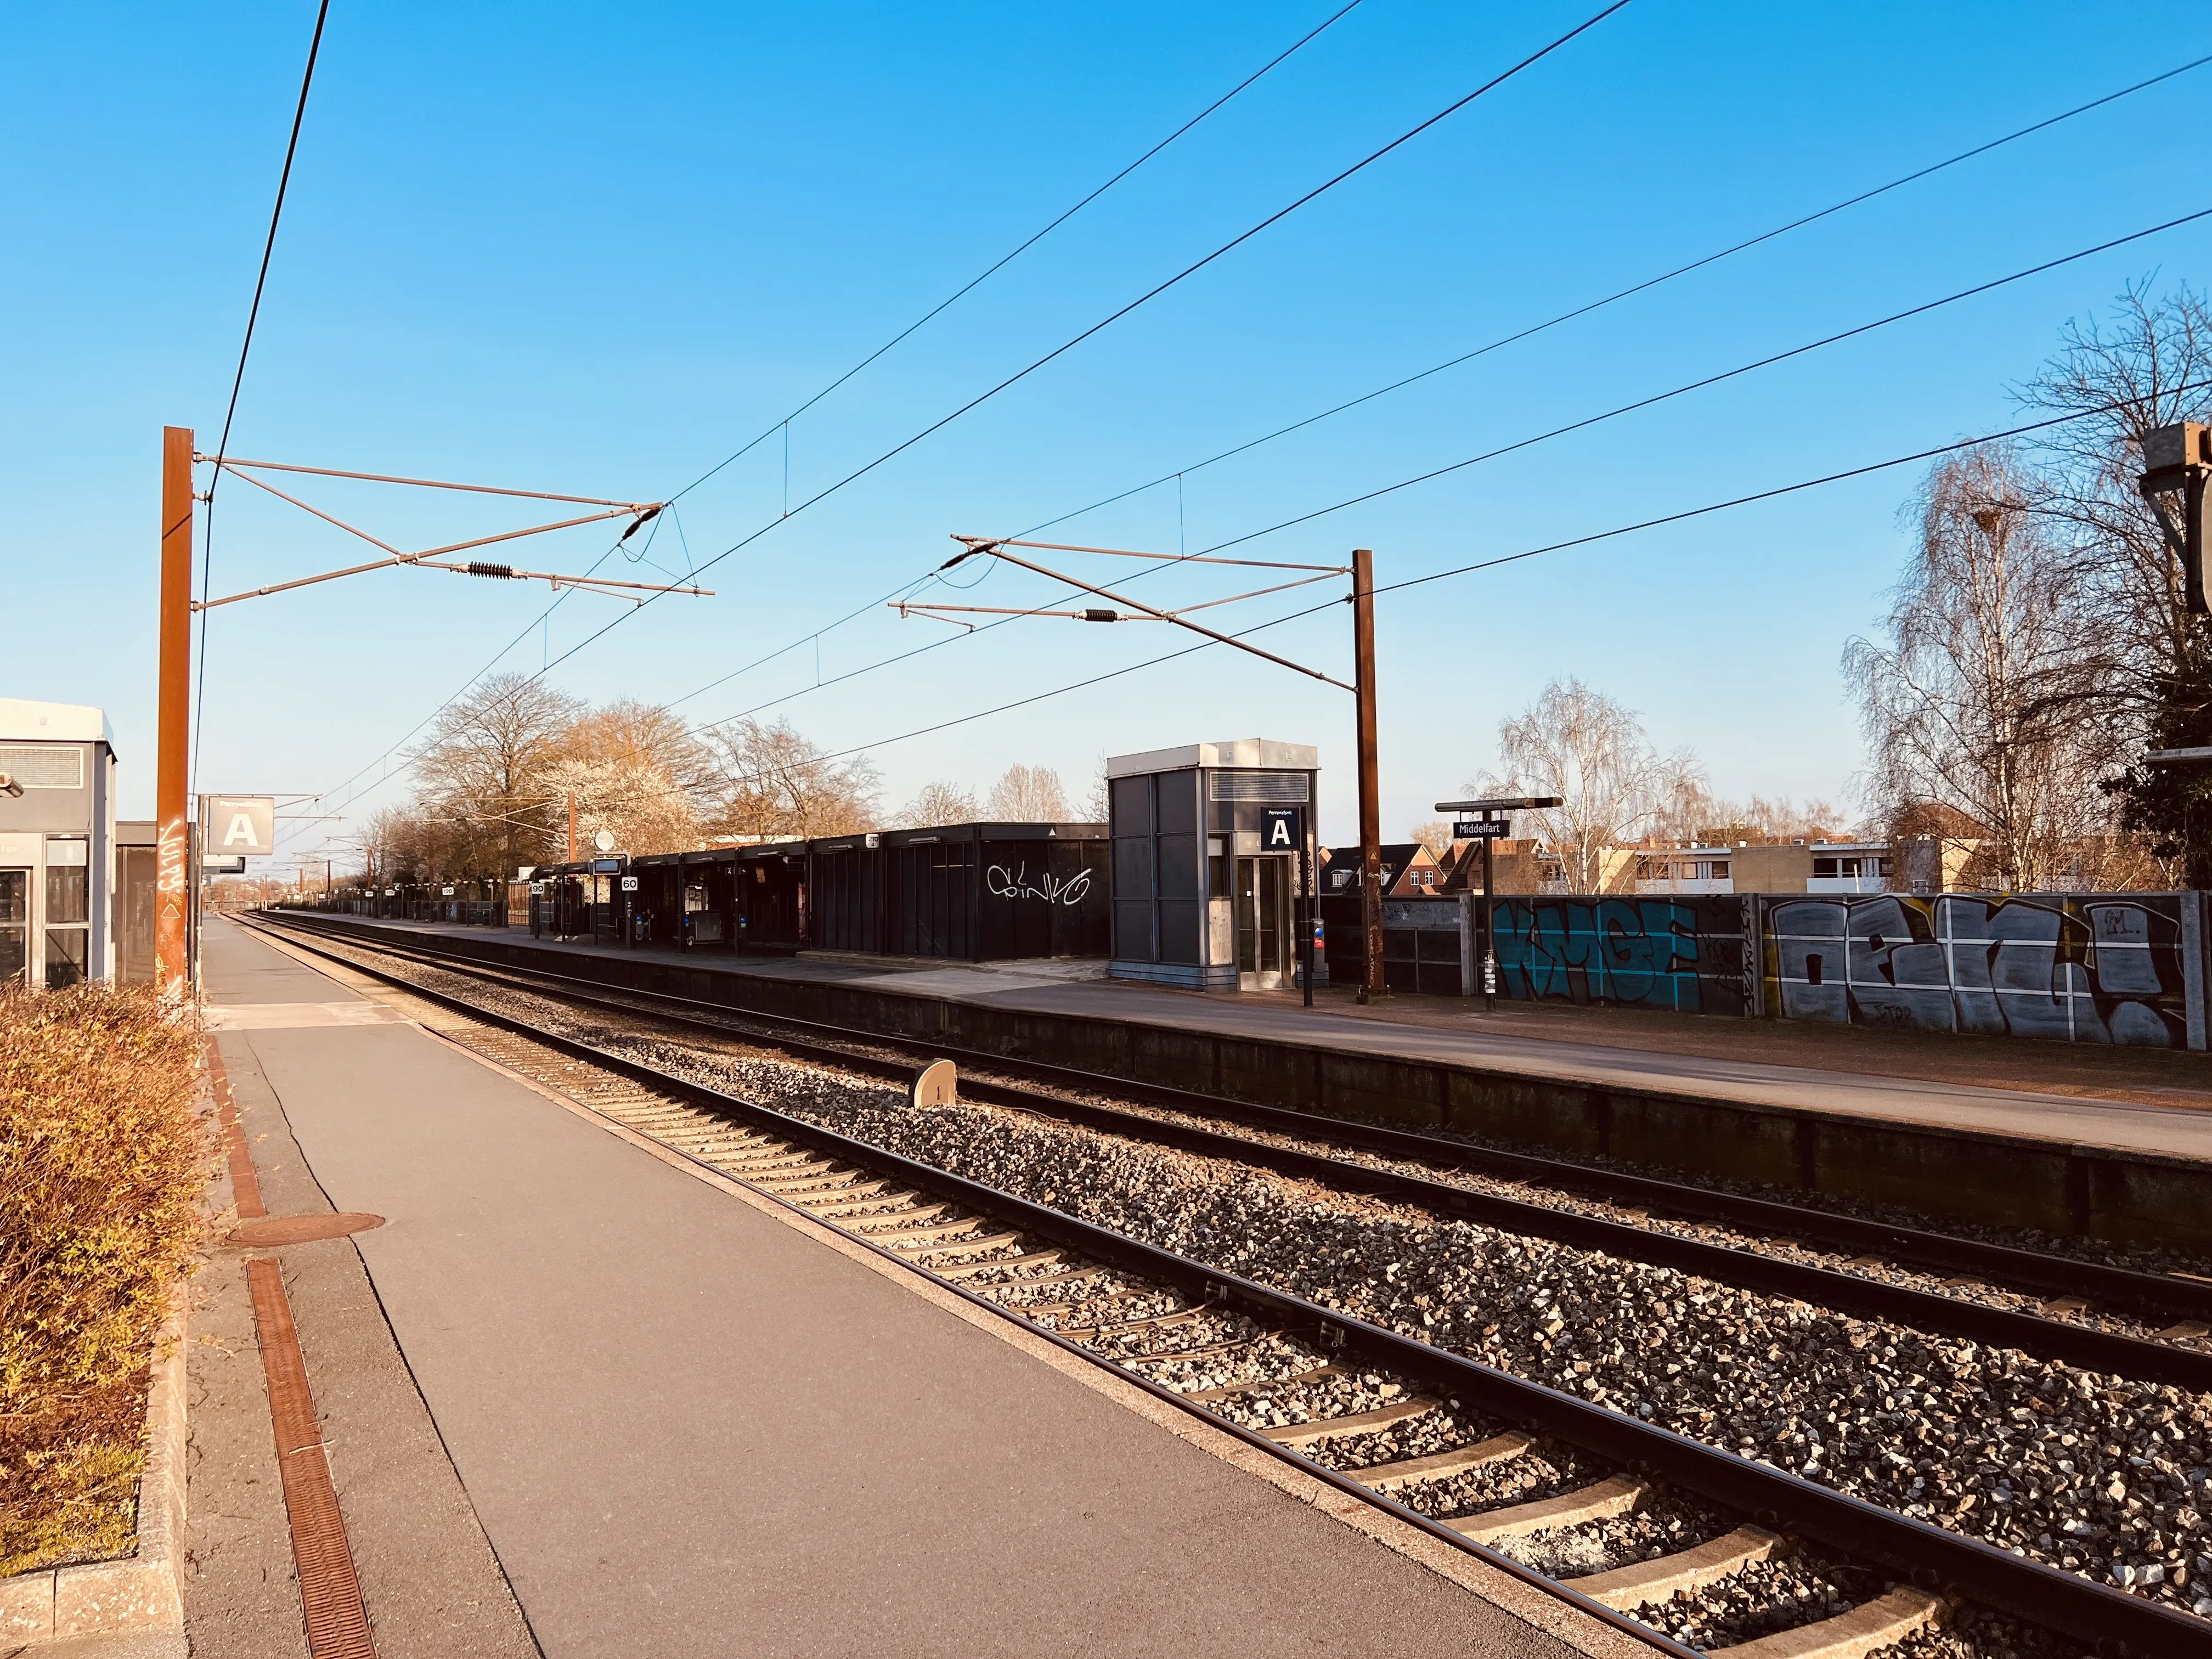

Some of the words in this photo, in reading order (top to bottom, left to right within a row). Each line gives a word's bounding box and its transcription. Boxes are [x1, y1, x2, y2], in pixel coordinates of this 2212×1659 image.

[223, 813, 259, 846] A
[1271, 820, 1291, 845] A
[1459, 823, 1500, 834] Middelfart
[623, 880, 636, 888] 60
